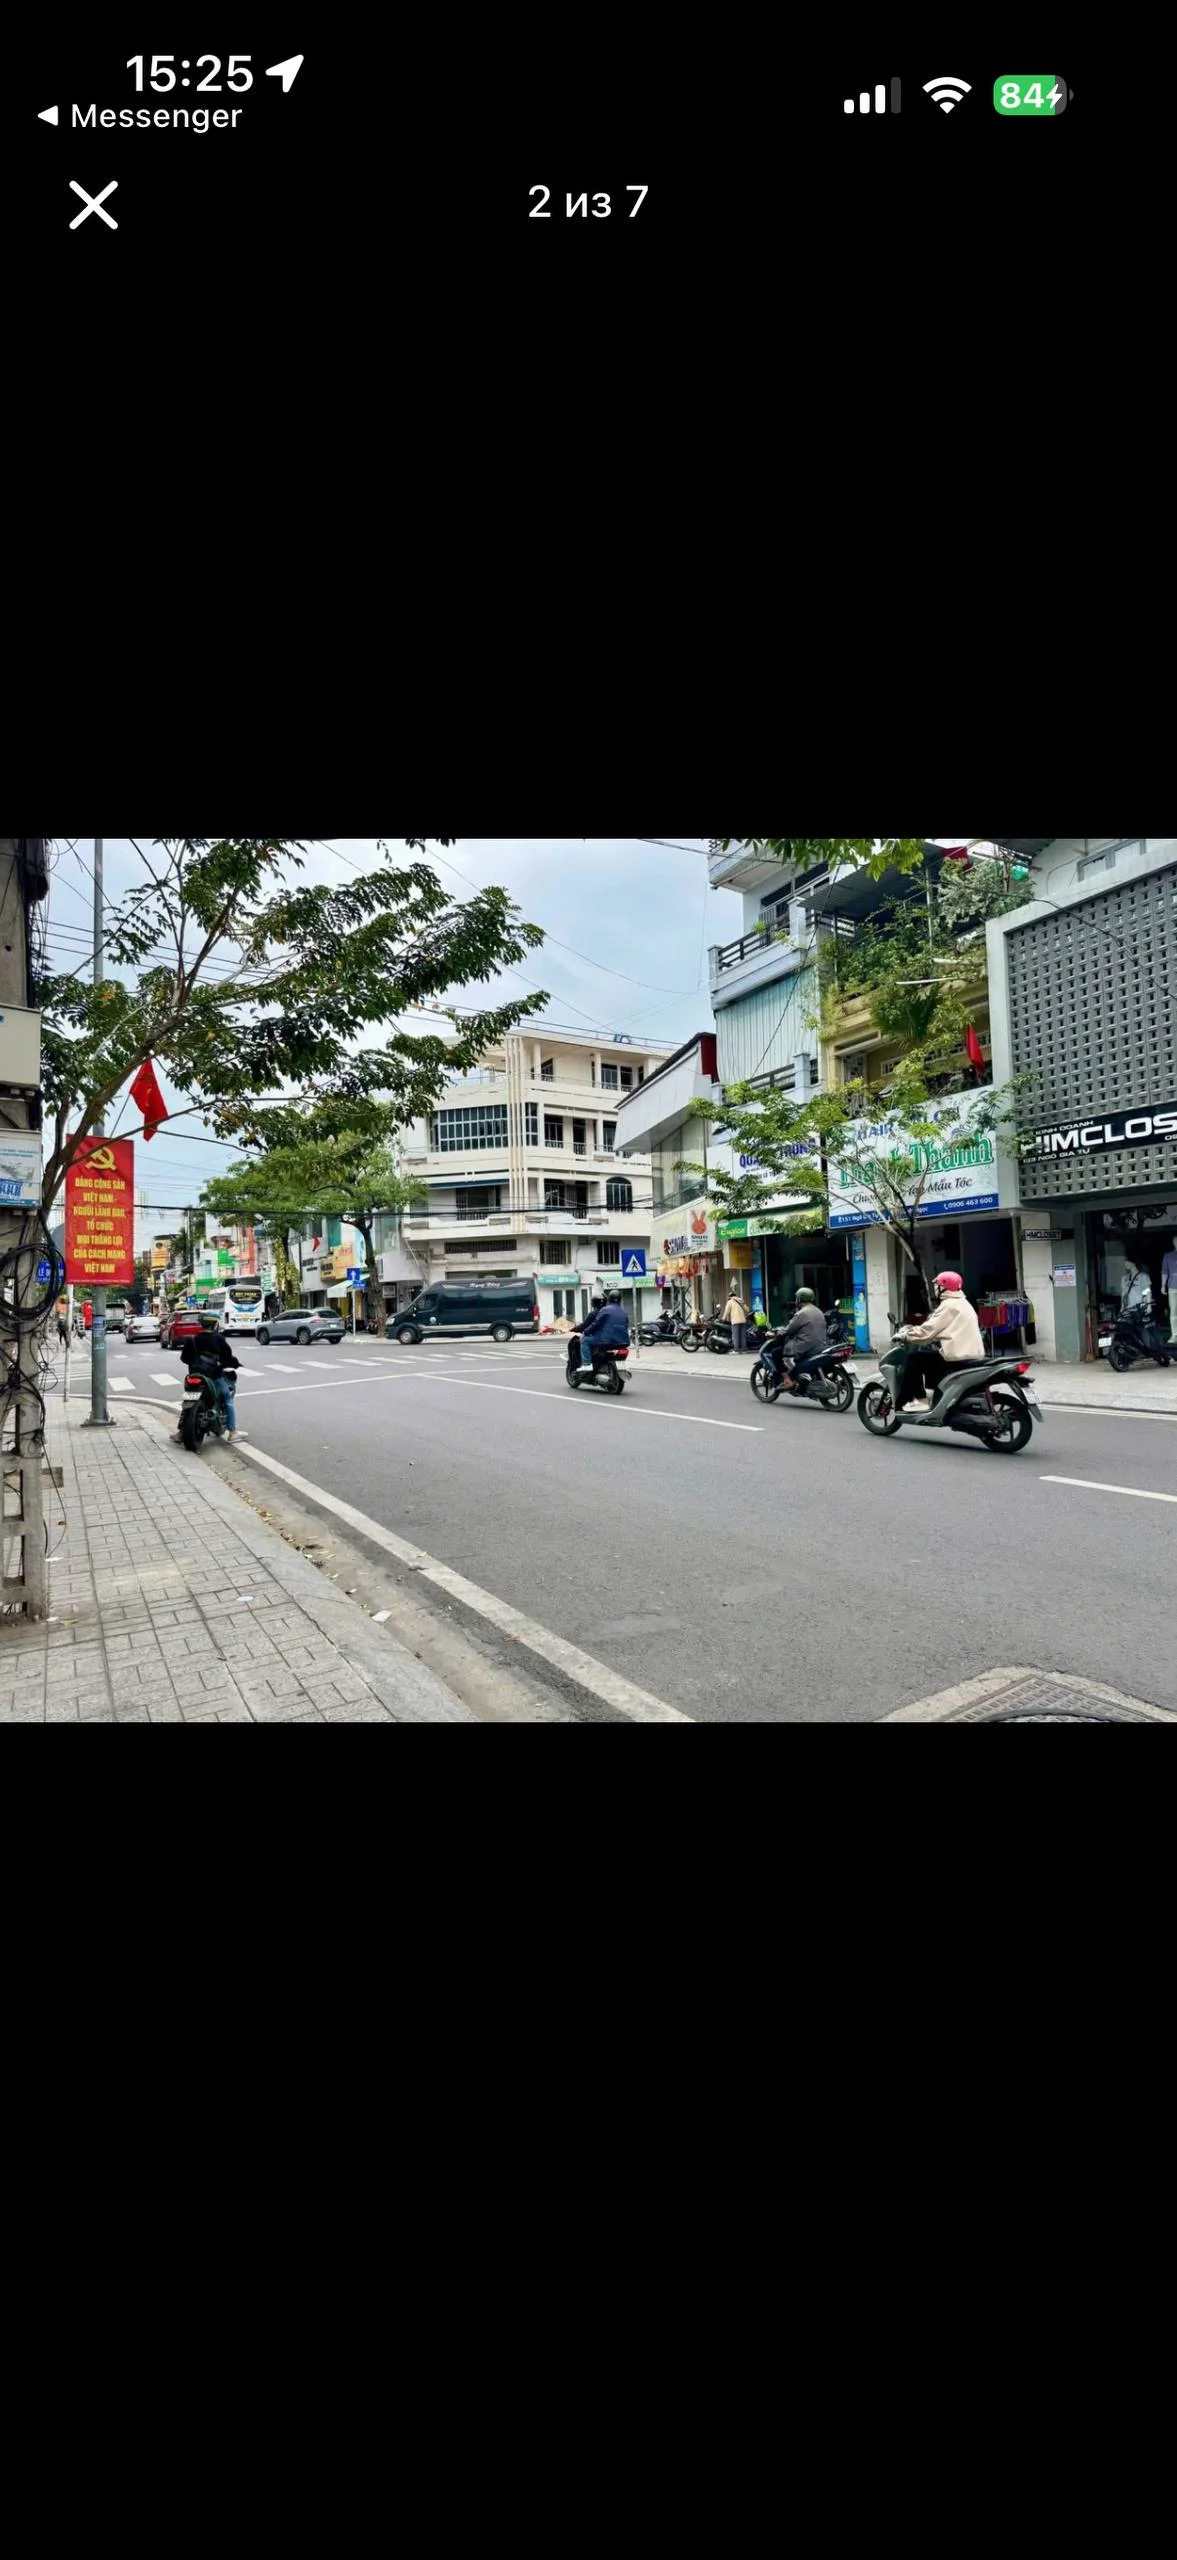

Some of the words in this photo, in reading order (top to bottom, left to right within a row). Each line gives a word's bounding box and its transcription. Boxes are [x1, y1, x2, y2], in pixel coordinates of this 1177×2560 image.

[1059, 1120, 1094, 1131] DOANH
[1059, 1151, 1076, 1159] GIA
[101, 1264, 115, 1273] NAM
